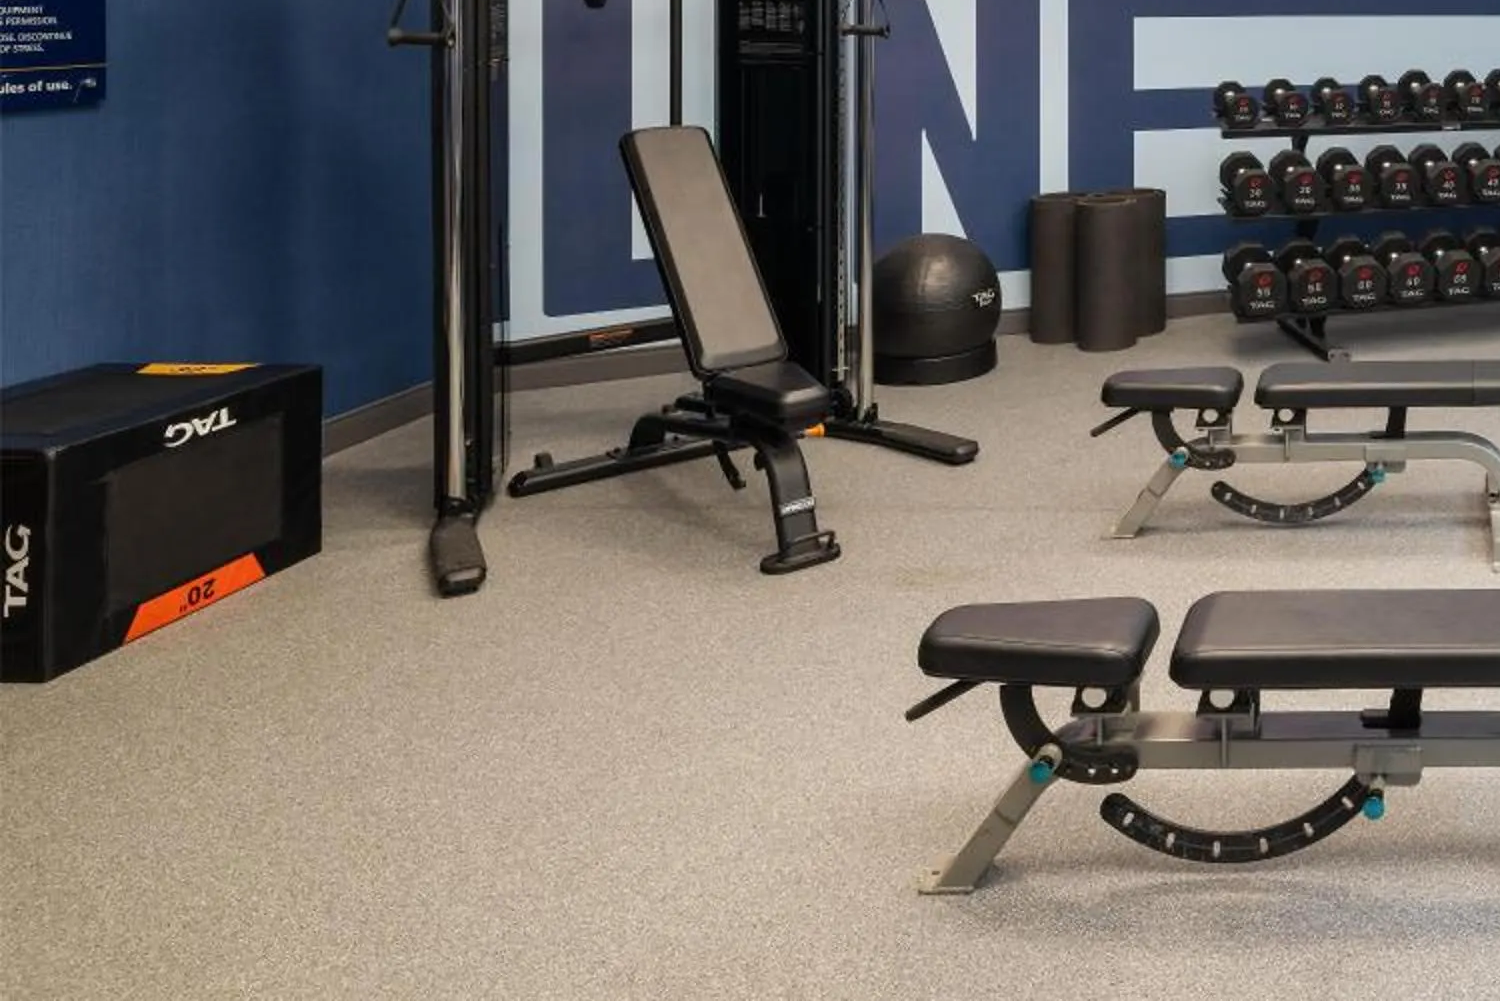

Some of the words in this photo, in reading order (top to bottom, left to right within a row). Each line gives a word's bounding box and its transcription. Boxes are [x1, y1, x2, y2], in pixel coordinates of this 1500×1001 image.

[27, 80, 43, 93] of
[46, 80, 73, 93] use.
[163, 406, 237, 448] TAG
[3, 523, 32, 619] TAG
[179, 577, 216, 614] 20"
